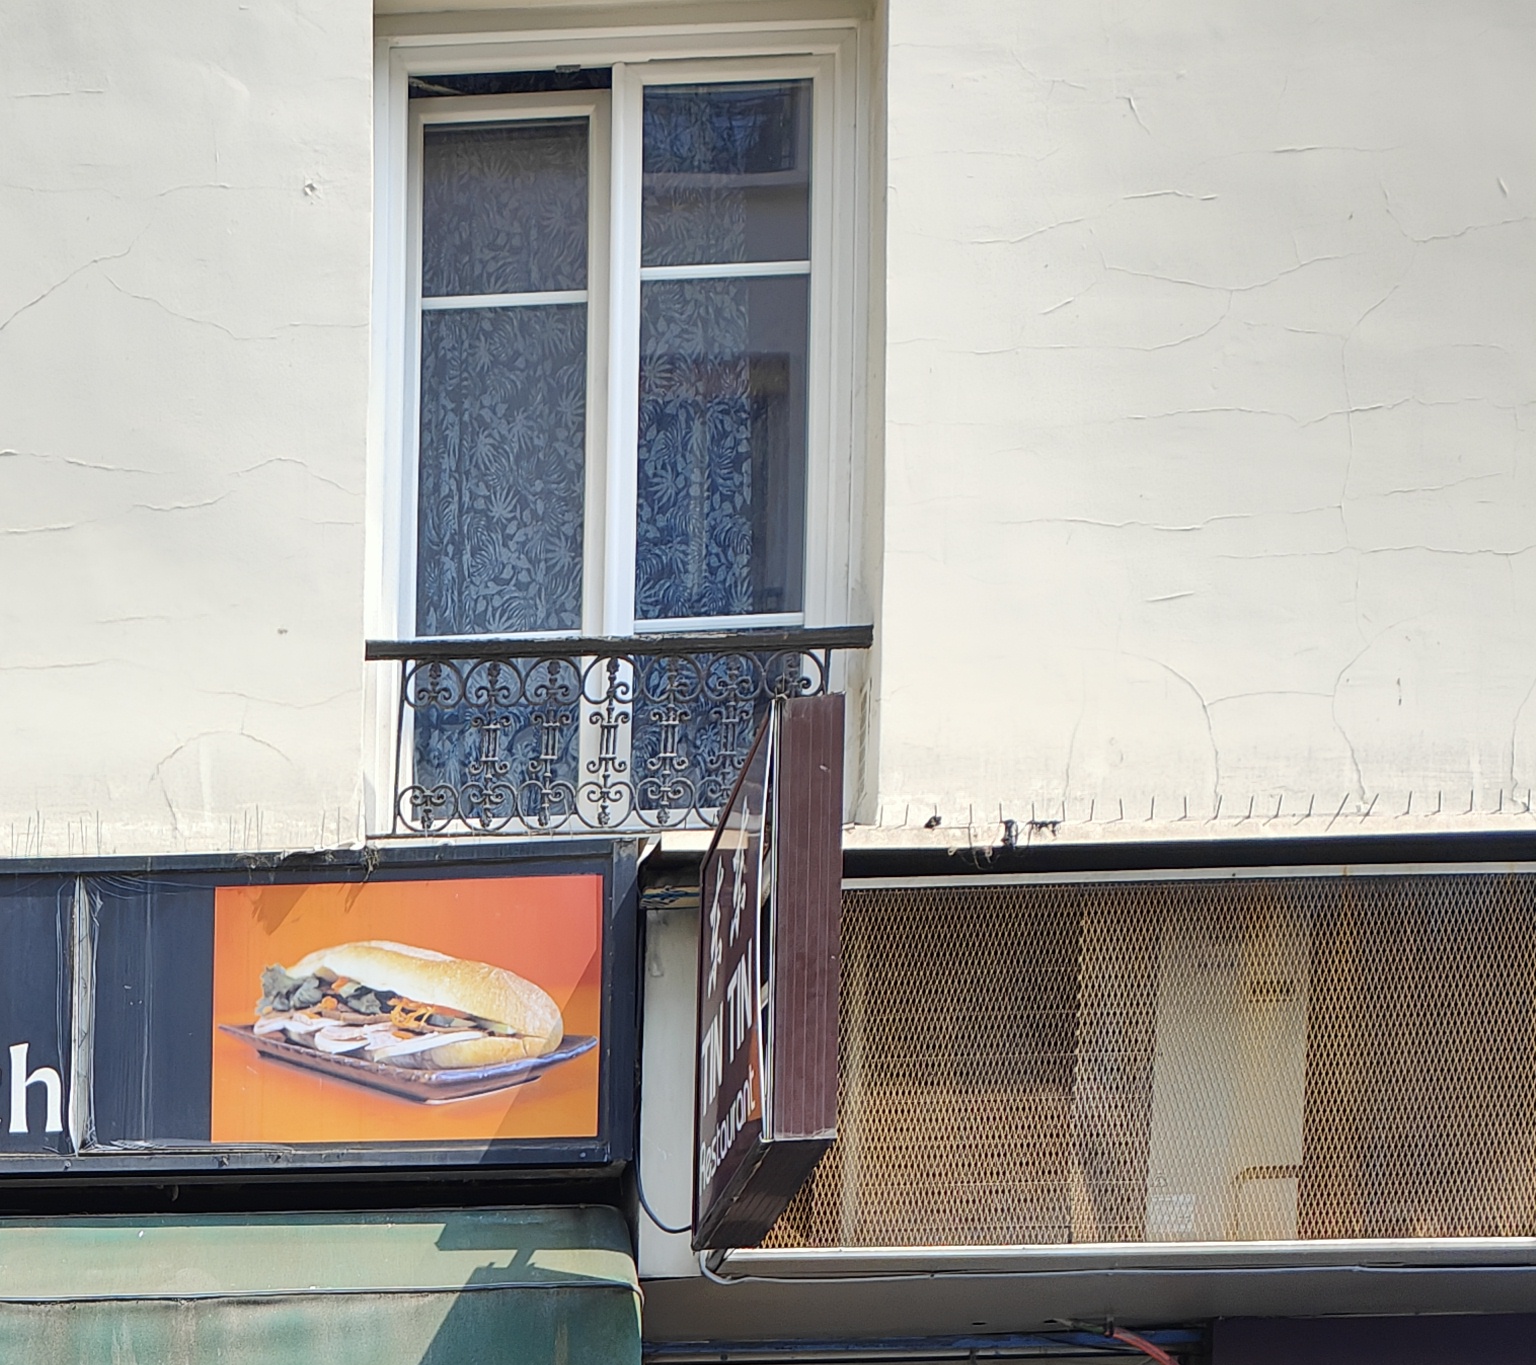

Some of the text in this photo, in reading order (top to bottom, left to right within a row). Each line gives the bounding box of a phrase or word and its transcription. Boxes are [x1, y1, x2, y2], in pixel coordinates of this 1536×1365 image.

[701, 1001, 724, 1116] TIN
[727, 939, 753, 1064] TIN
[699, 1064, 757, 1198] Restaurant
